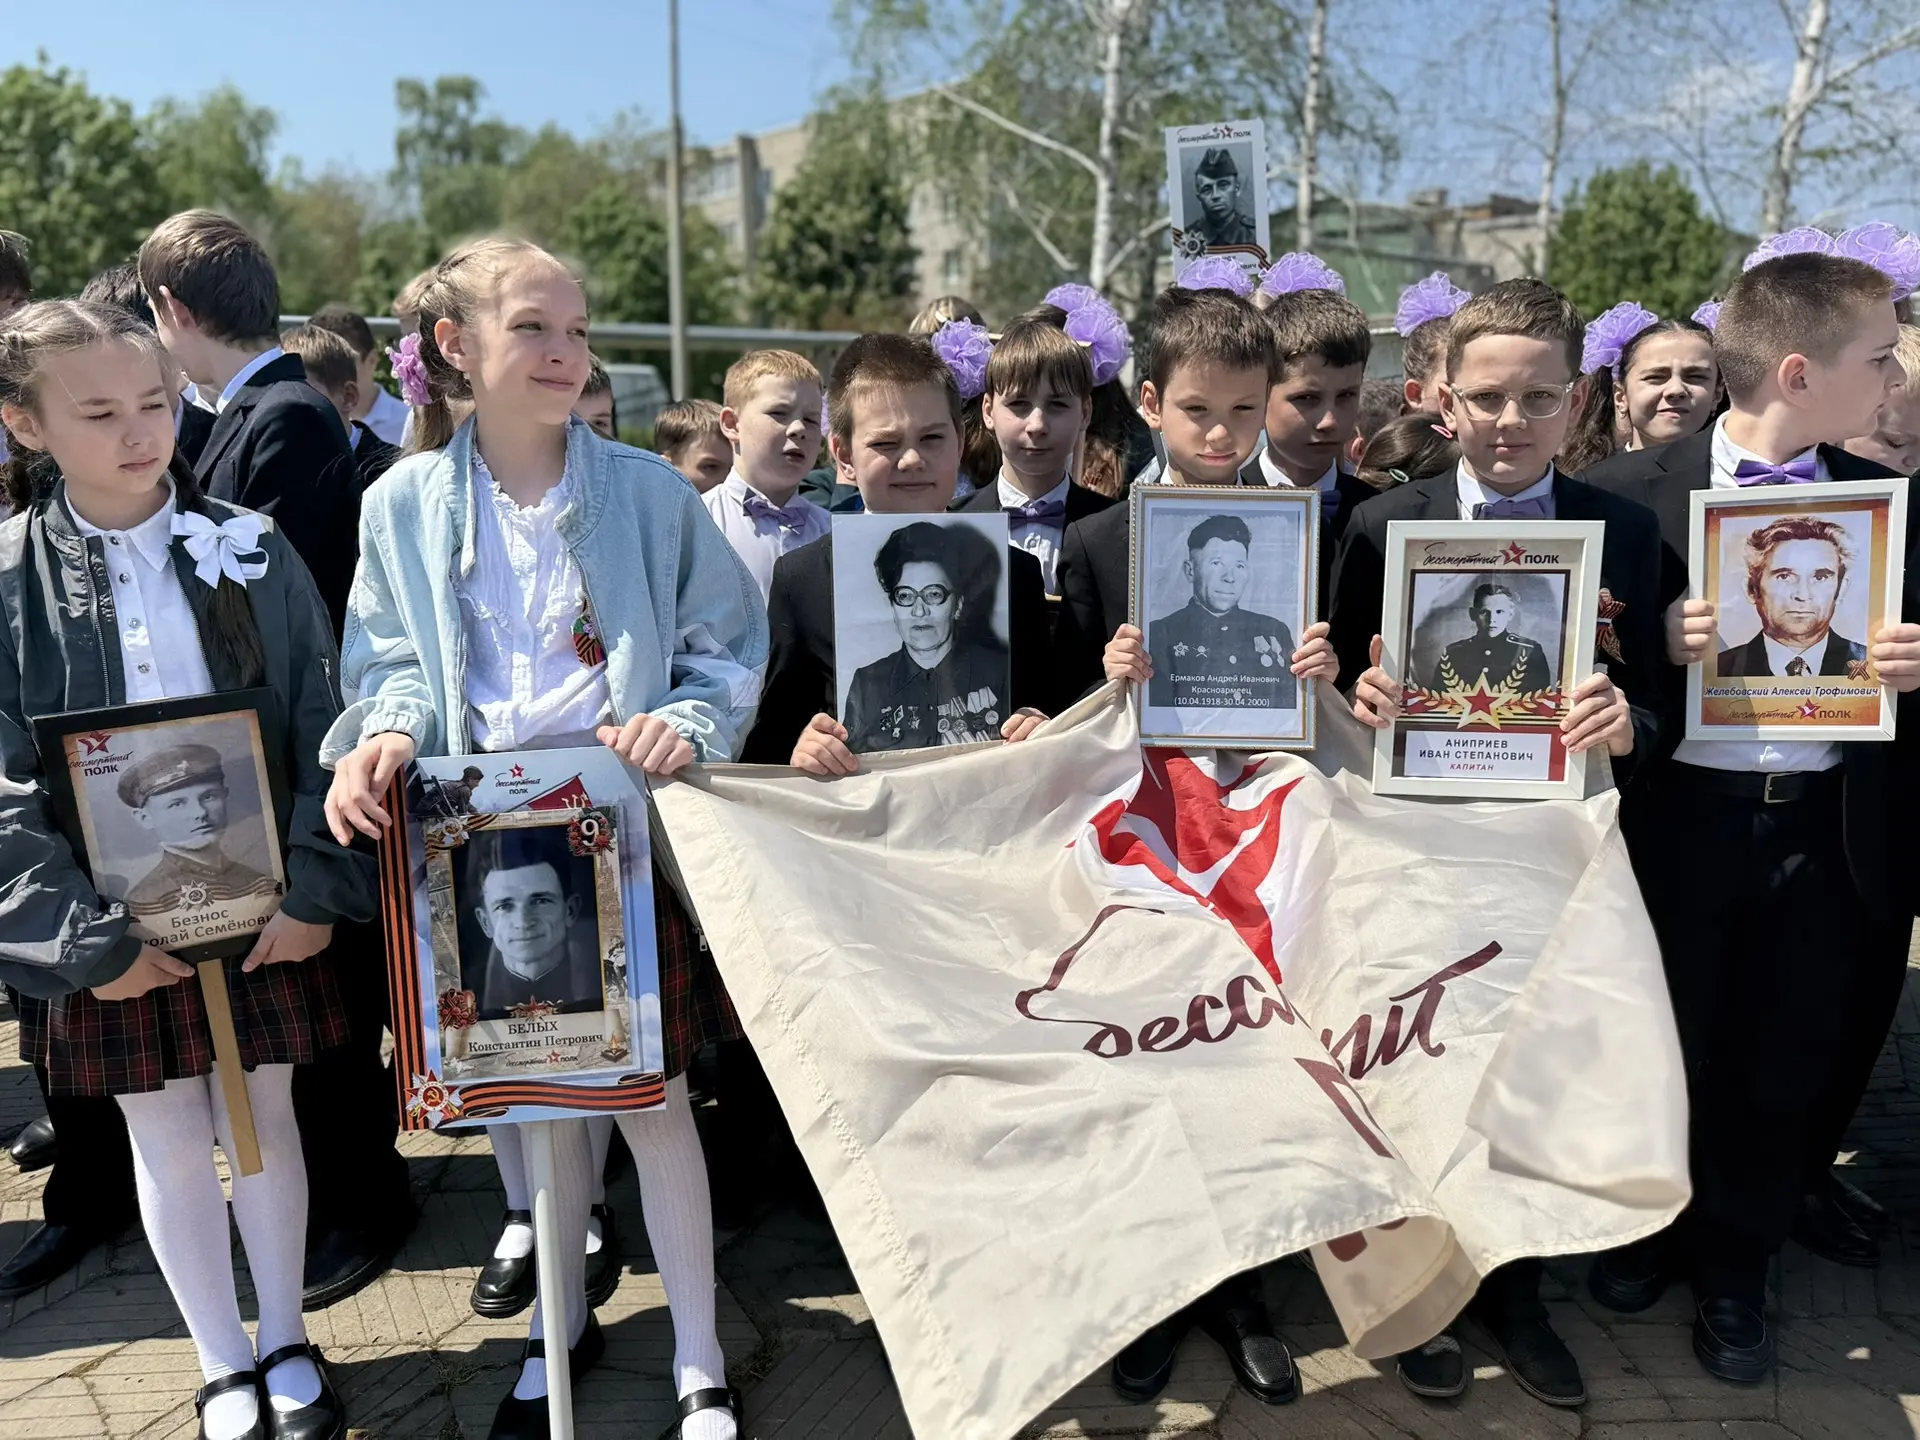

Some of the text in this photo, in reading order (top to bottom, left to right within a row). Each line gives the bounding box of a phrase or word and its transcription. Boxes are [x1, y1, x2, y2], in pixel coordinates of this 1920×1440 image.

[1524, 554, 1560, 564] ПОЛК
[1170, 673, 1280, 684] Ермаков Андрей Иванович
[1191, 686, 1252, 696] Красноармеец
[1704, 686, 1878, 697] Желебовский Алексей Трофимович
[1819, 710, 1852, 719] ПОЛК
[1445, 739, 1508, 748] АНИПРИЕВ
[1419, 750, 1533, 761] ИВАН СТЕПАНОВИЧ
[84, 764, 119, 777] ПОЛК
[1450, 763, 1495, 771] КАПИТАН
[581, 818, 600, 847] 9
[171, 909, 230, 929] Безнос
[144, 913, 274, 948] олай Семёнови
[508, 1021, 558, 1035] БЕЛЫХ
[469, 1033, 603, 1053] Константин Петрович
